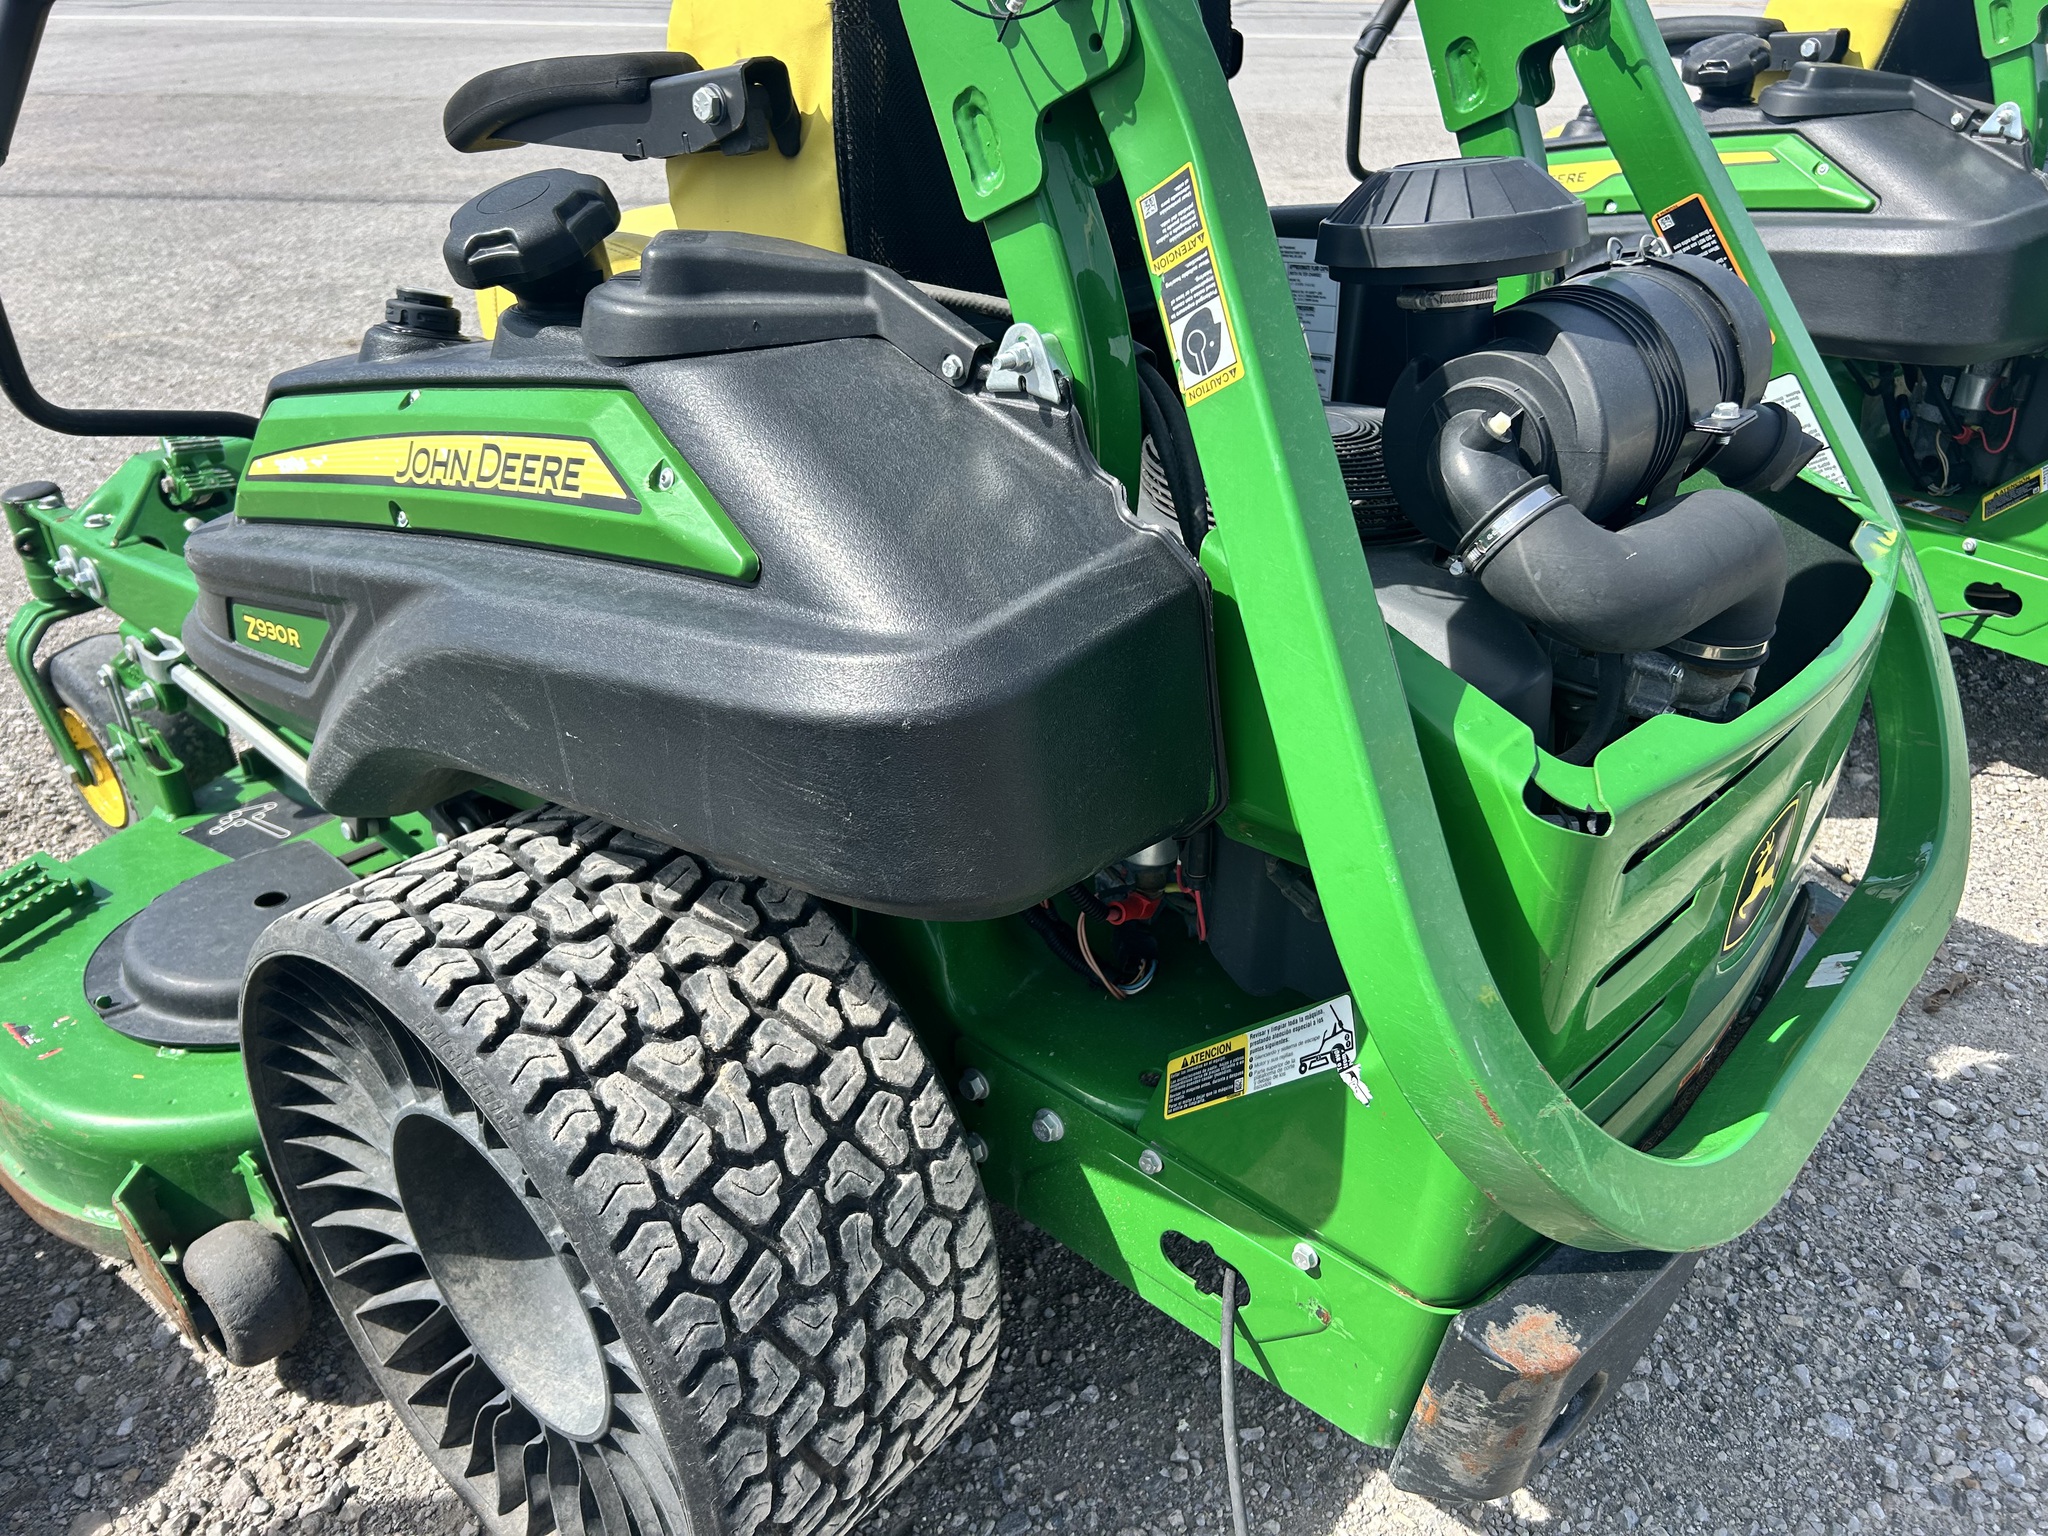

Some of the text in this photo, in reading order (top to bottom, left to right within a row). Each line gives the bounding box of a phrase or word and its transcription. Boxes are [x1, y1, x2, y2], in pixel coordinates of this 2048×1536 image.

[1152, 236, 1198, 273] ATENCION
[1188, 370, 1229, 402] CAUTION
[395, 440, 586, 492] JOHN DEERE
[242, 615, 301, 649] Z930R
[1249, 1028, 1266, 1040] Revisar
[1270, 1021, 1286, 1033] limpiar
[1287, 1017, 1297, 1027] toda
[1249, 1034, 1270, 1048] prestando
[1292, 1020, 1312, 1033] especial
[1189, 1040, 1231, 1065] ATENCION
[417, 1015, 521, 1131] MICHELIN
